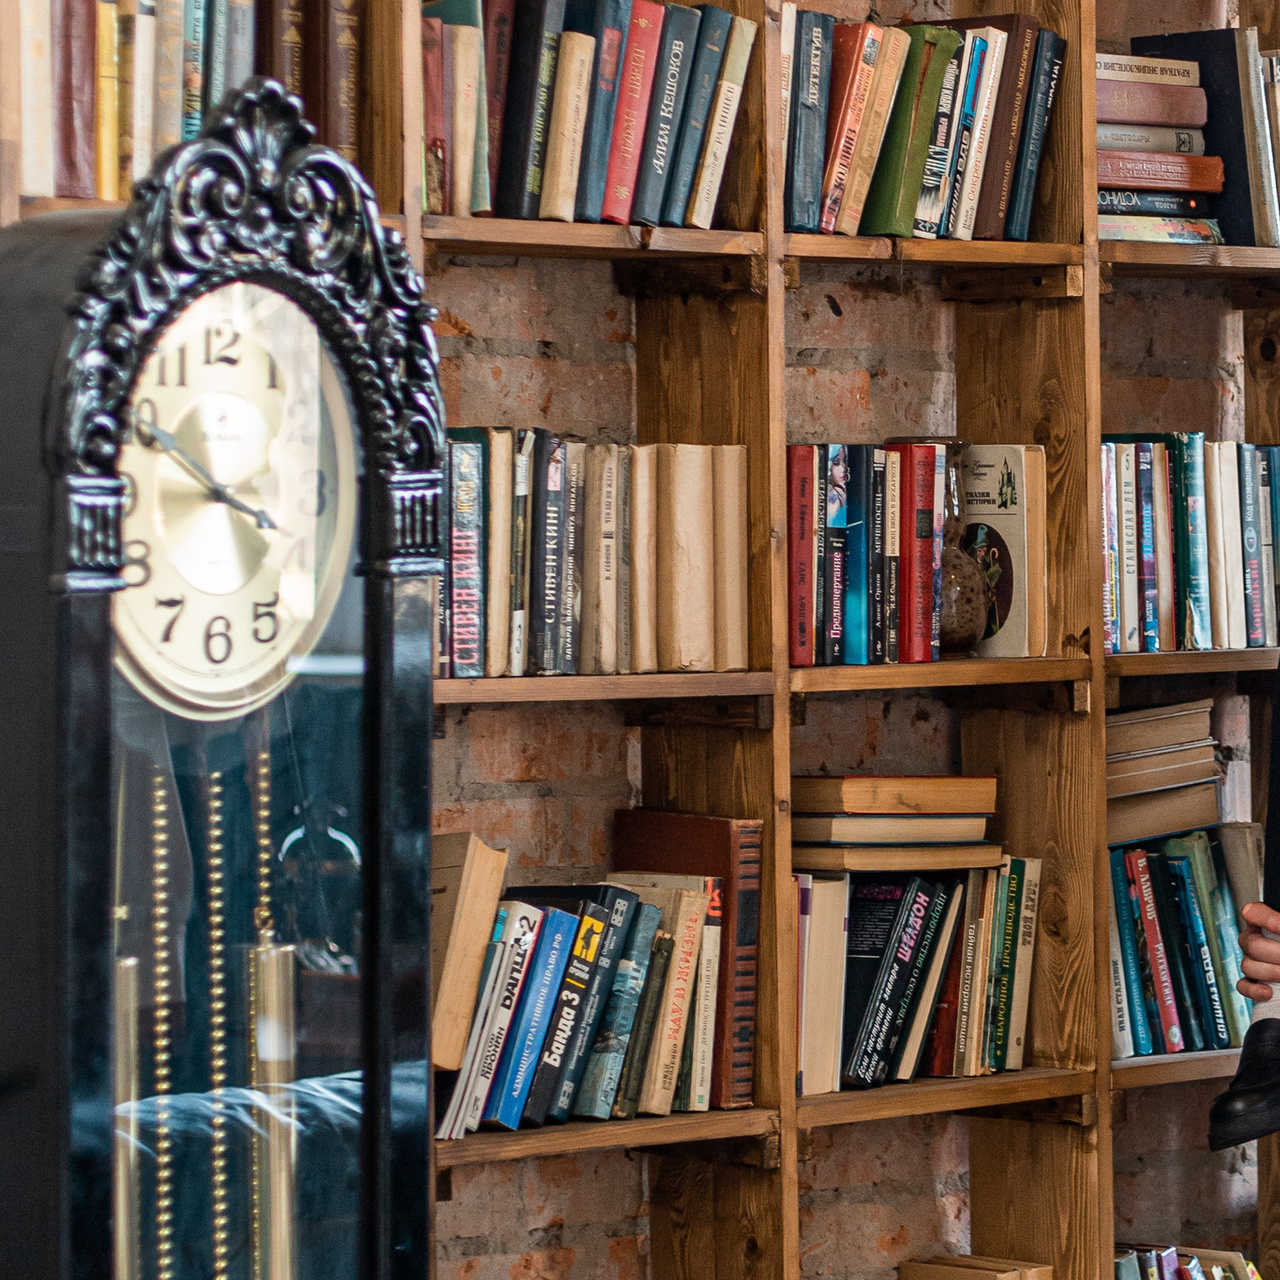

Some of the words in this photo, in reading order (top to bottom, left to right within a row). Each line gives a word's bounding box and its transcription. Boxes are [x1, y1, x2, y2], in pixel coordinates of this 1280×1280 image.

[189, 17, 202, 75] ЖЮЛЬЕТТА
[626, 42, 647, 99] ЦВЕЙГ
[808, 27, 822, 106] ДЕТЕКТИВ
[1015, 29, 1033, 89] МАКЕДОНСКИЙ
[660, 39, 685, 119] КЕШОКОВ
[1160, 66, 1191, 78] КРАТКАЯ
[531, 87, 548, 142] КОНСУЭЛО
[938, 89, 955, 114] КЛАРК
[1009, 92, 1022, 139] АЛЕКСАНДР
[620, 108, 639, 170] СТЕФАН
[652, 122, 671, 174] АЛИМ
[936, 116, 948, 147] КРОВАВАЯ
[957, 130, 971, 172] ВДВ
[974, 114, 989, 155] вашей
[833, 128, 857, 190] КОЛЛИНЗ
[967, 158, 983, 202] Секрет
[156, 344, 189, 388] 11
[202, 321, 241, 368] 12
[456, 480, 476, 514] ИСХОД
[568, 463, 578, 513] МИХАЛКОВ
[1123, 480, 1134, 504] ЛЕМ
[1244, 451, 1254, 504] возвращения
[545, 501, 559, 549] КИНГ
[567, 515, 577, 551] НИКИТА
[873, 493, 883, 554] МЕЧЕНОСЕЦ
[1245, 506, 1254, 522] Код
[122, 539, 152, 588] 8
[452, 527, 478, 580] КИНГ
[1125, 509, 1136, 575] СТАНИСЛАВ
[544, 553, 558, 624] СТИВЕН
[830, 551, 843, 639] Предначертание
[874, 573, 883, 601] Орлов
[1244, 568, 1253, 596] Данил
[1246, 559, 1264, 640] Корецкий
[155, 593, 186, 644] 7
[251, 592, 280, 644] 5
[453, 587, 479, 665] СТИВЕН
[875, 602, 883, 629] Алекс
[203, 615, 234, 666] 6
[563, 625, 573, 661] ЭДУАРД
[1135, 856, 1147, 872] В.
[1139, 872, 1157, 920] ЛАВРОВ
[896, 891, 931, 962] ШЕЛДОН
[914, 892, 948, 968] пророчество
[965, 923, 977, 962] тайная
[1001, 874, 1018, 968] ПРОИЗВОДСТВО
[1021, 915, 1035, 947] ТВОЙ
[499, 915, 537, 1011] БАНДА-2
[703, 958, 712, 973] ГОД
[1123, 923, 1138, 980] МЕНЕДЖЕРА
[1199, 945, 1216, 985] ВДВ
[672, 985, 689, 999] В
[702, 973, 711, 1001] ТРЕТИЙ
[893, 978, 918, 1027] сестрах
[961, 964, 976, 1012] история
[1112, 959, 1124, 1005] СТАДНЮК
[512, 987, 548, 1099] АДМИНИСТРАТИВНОЕ
[542, 950, 560, 985] ПРАВО
[552, 933, 564, 949] РФ
[543, 1006, 579, 1068] Банда
[563, 991, 580, 1005] 3
[667, 999, 686, 1040] ИДУ
[701, 1003, 710, 1046] ДЕВЯНОСТО
[856, 1054, 869, 1080] Если
[864, 1002, 887, 1053] наступит
[881, 962, 900, 1001] завтра
[957, 1013, 970, 1053] вещей
[995, 973, 1011, 1045] СВАРОЧНОЕ
[1117, 1006, 1127, 1033] ИВАН
[1130, 982, 1147, 1044] СПРАВОЧНИК
[1209, 986, 1228, 1040] СПЕЦНАЗ
[483, 1026, 505, 1080] ПРОНИН
[864, 1054, 877, 1083] Пески
[873, 1007, 894, 1051] времени
[661, 1063, 671, 1090] РОМАН
